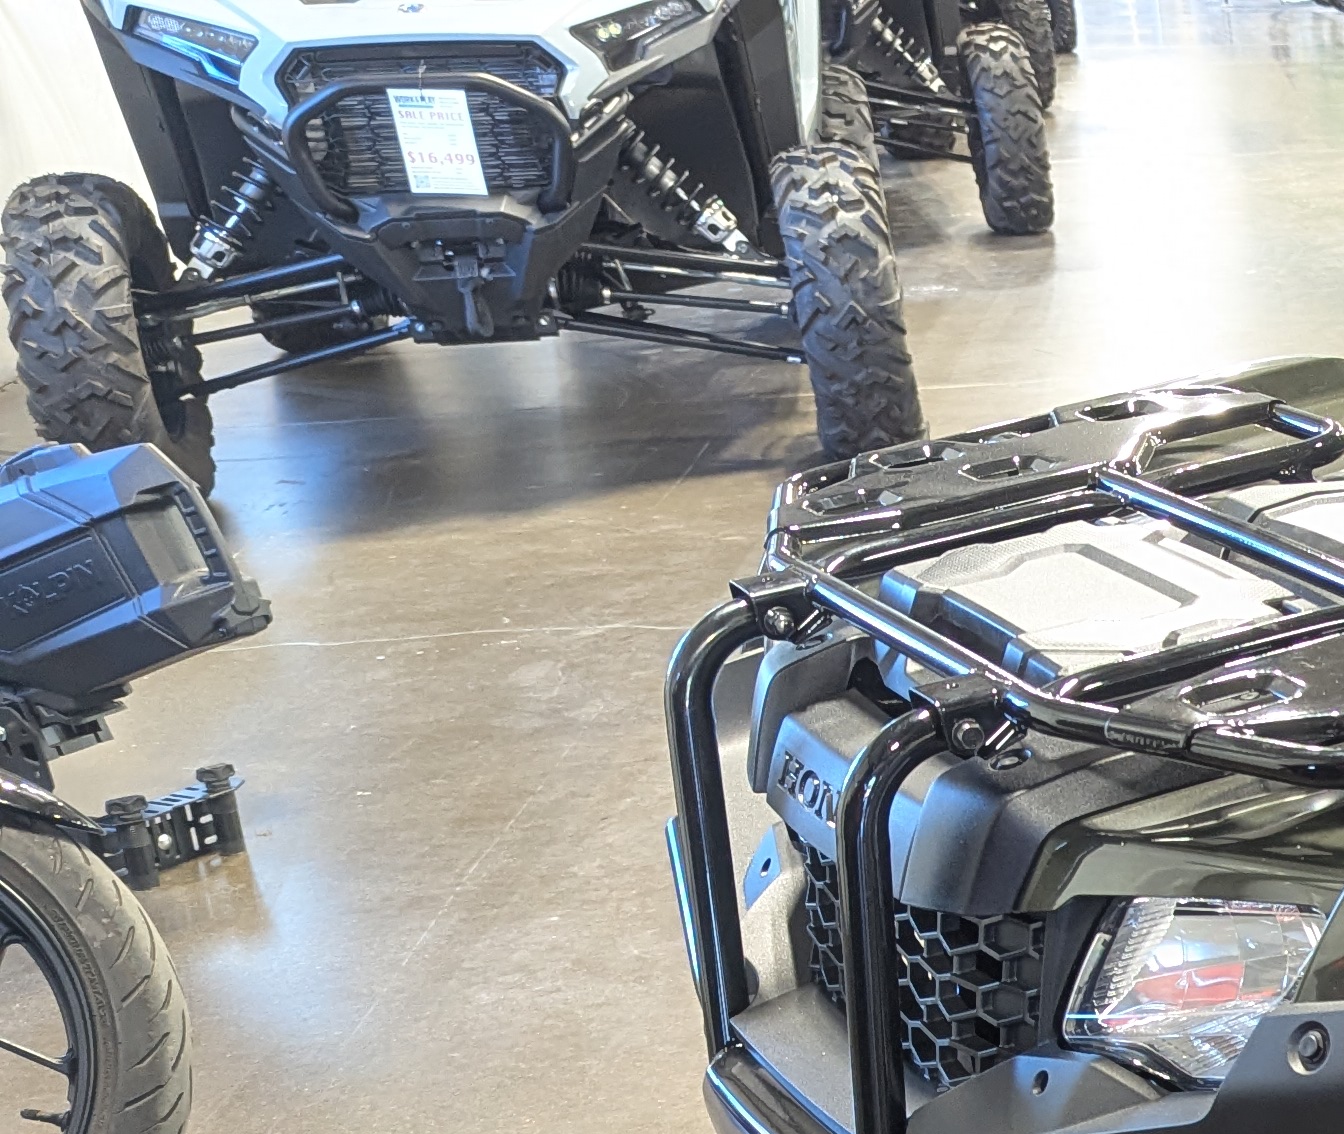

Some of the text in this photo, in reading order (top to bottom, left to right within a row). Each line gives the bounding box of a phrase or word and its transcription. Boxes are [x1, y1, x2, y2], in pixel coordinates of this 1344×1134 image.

[398, 110, 465, 121] SALE PRICE
[407, 150, 475, 166] $16,499
[777, 750, 843, 829] HON
